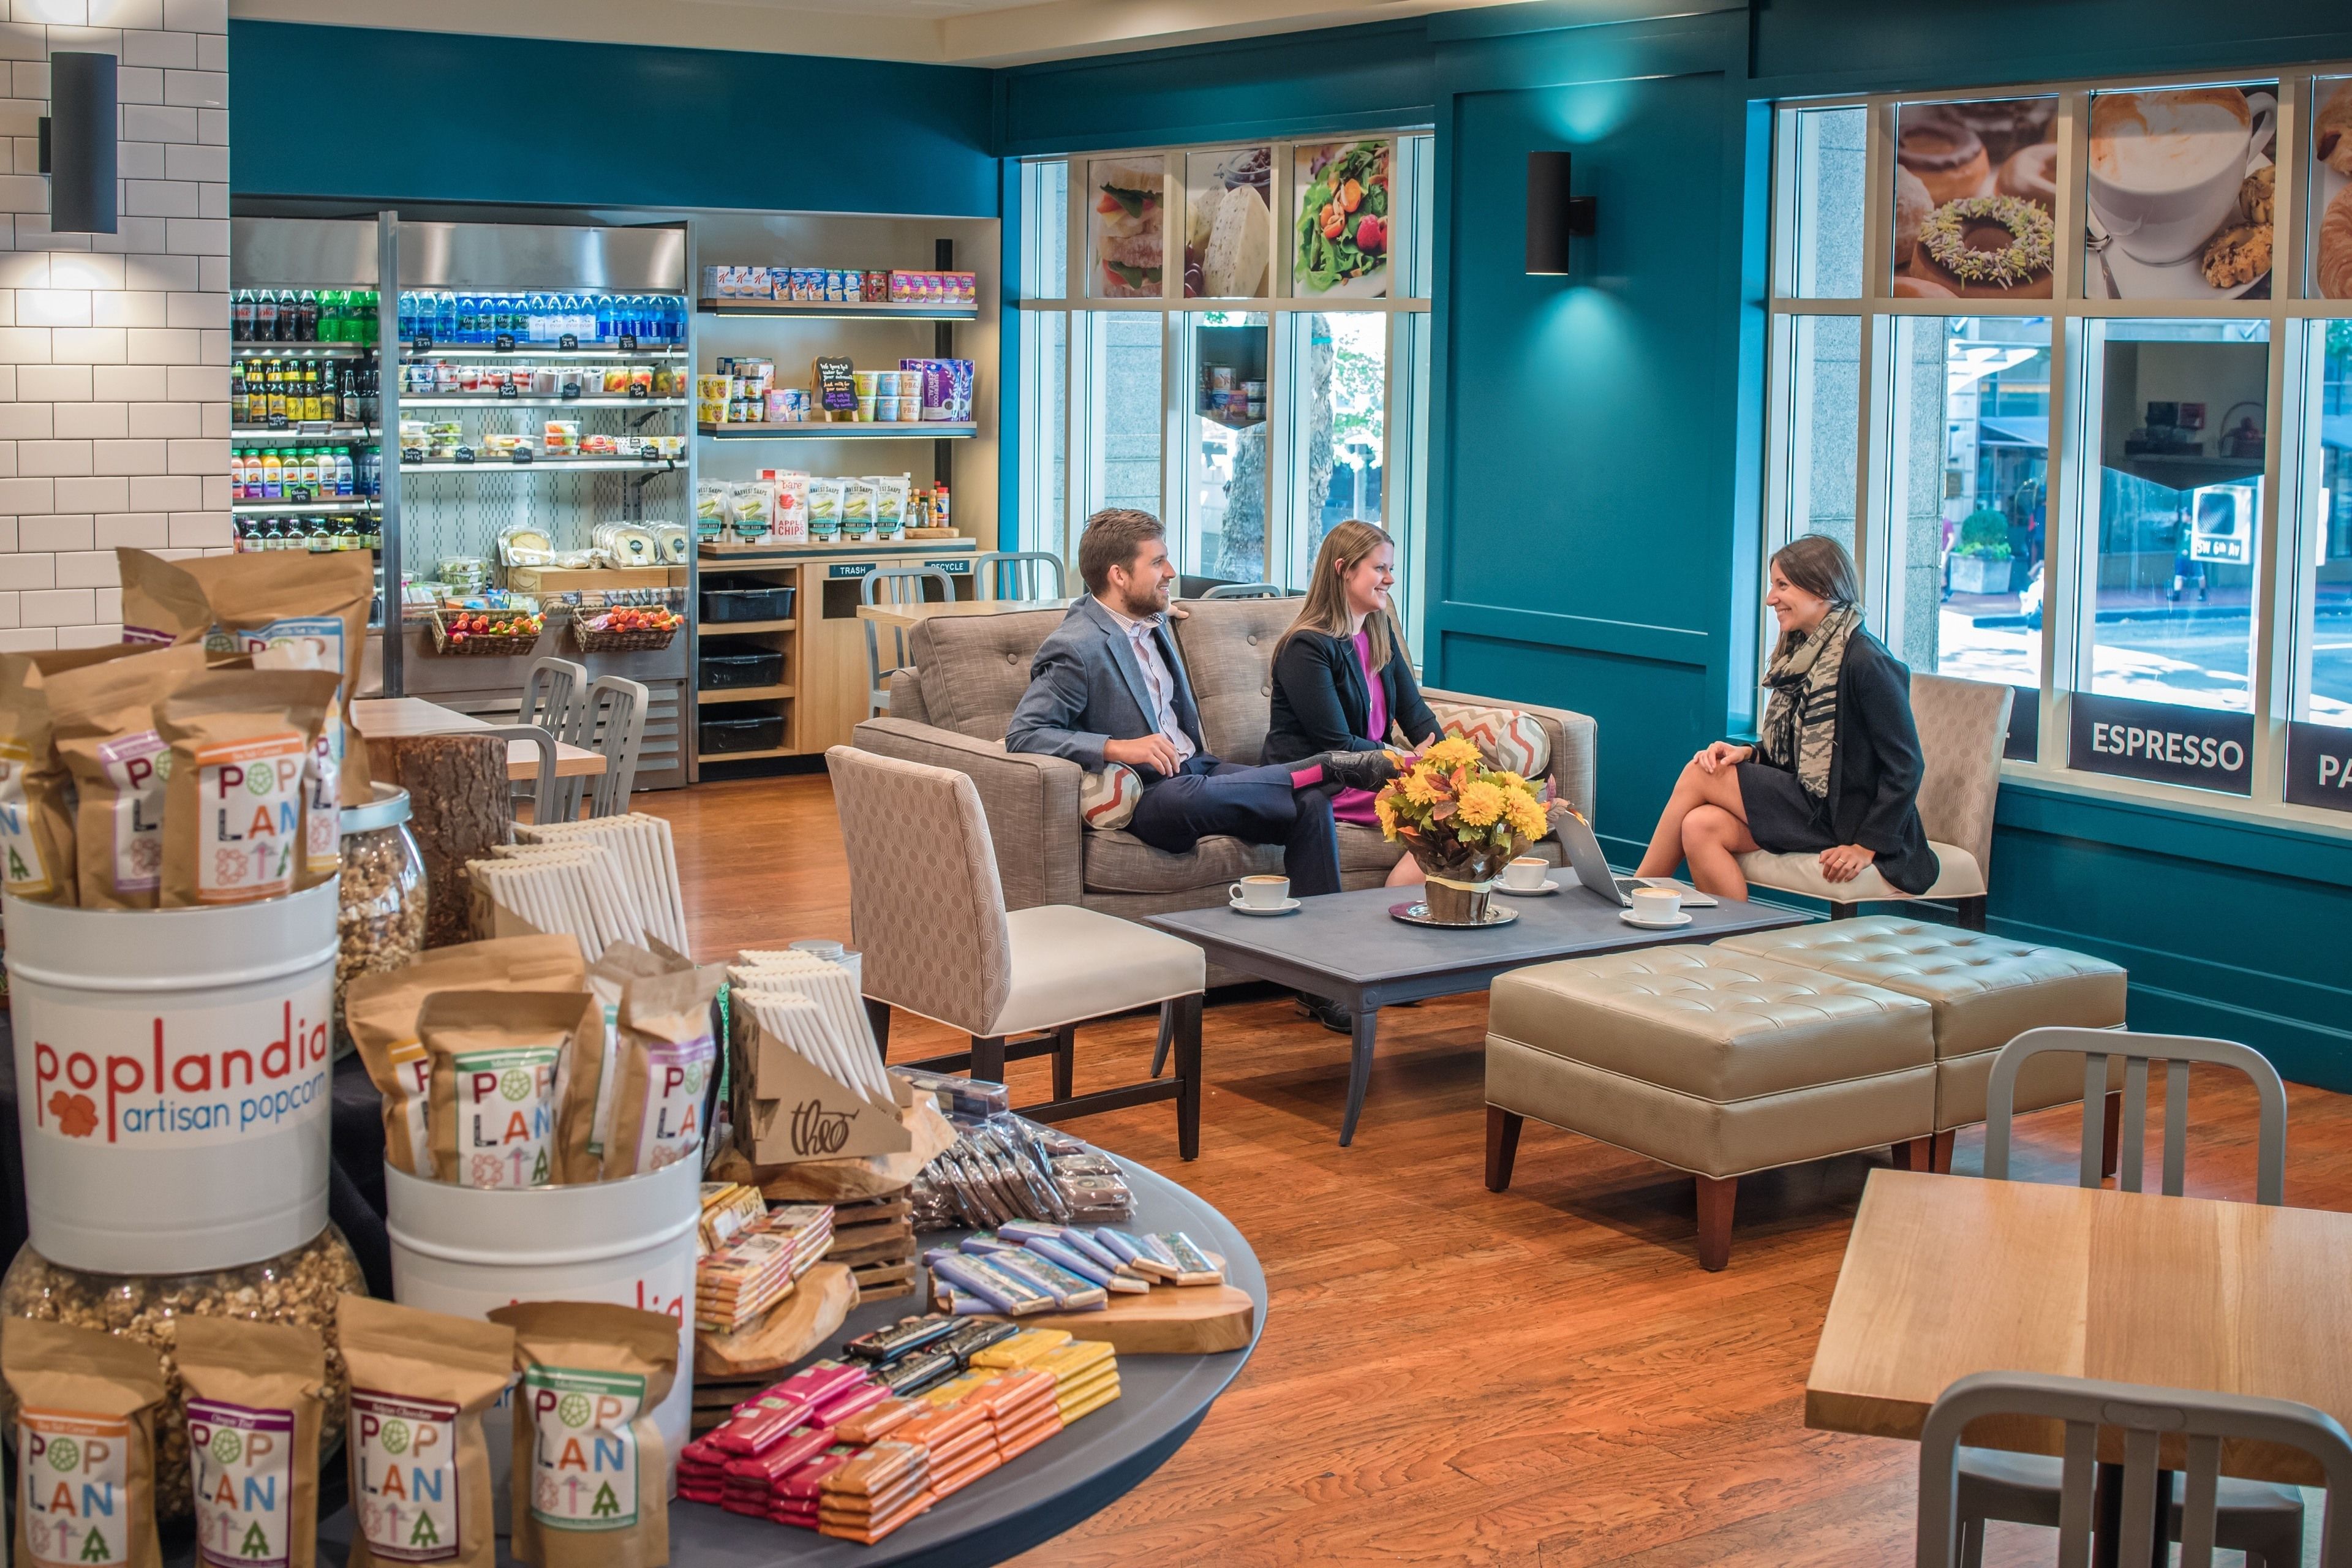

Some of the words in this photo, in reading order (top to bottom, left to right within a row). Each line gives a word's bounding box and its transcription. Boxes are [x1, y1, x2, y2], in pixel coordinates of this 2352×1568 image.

[778, 527, 804, 536] CHIPS
[2092, 723, 2244, 771] ESPRESSO
[218, 757, 298, 799] POP
[35, 1000, 327, 1144] poplandia
[123, 1099, 230, 1133] artisan
[239, 1071, 325, 1133] popcorn
[791, 1099, 861, 1156] theo
[535, 1389, 622, 1430] POP
[29, 1432, 110, 1474] POP
[191, 1423, 273, 1468] POP
[360, 1414, 438, 1458] POP
[29, 1474, 113, 1518] LAN
[198, 1461, 275, 1512] LAN
[360, 1457, 442, 1502] LAN
